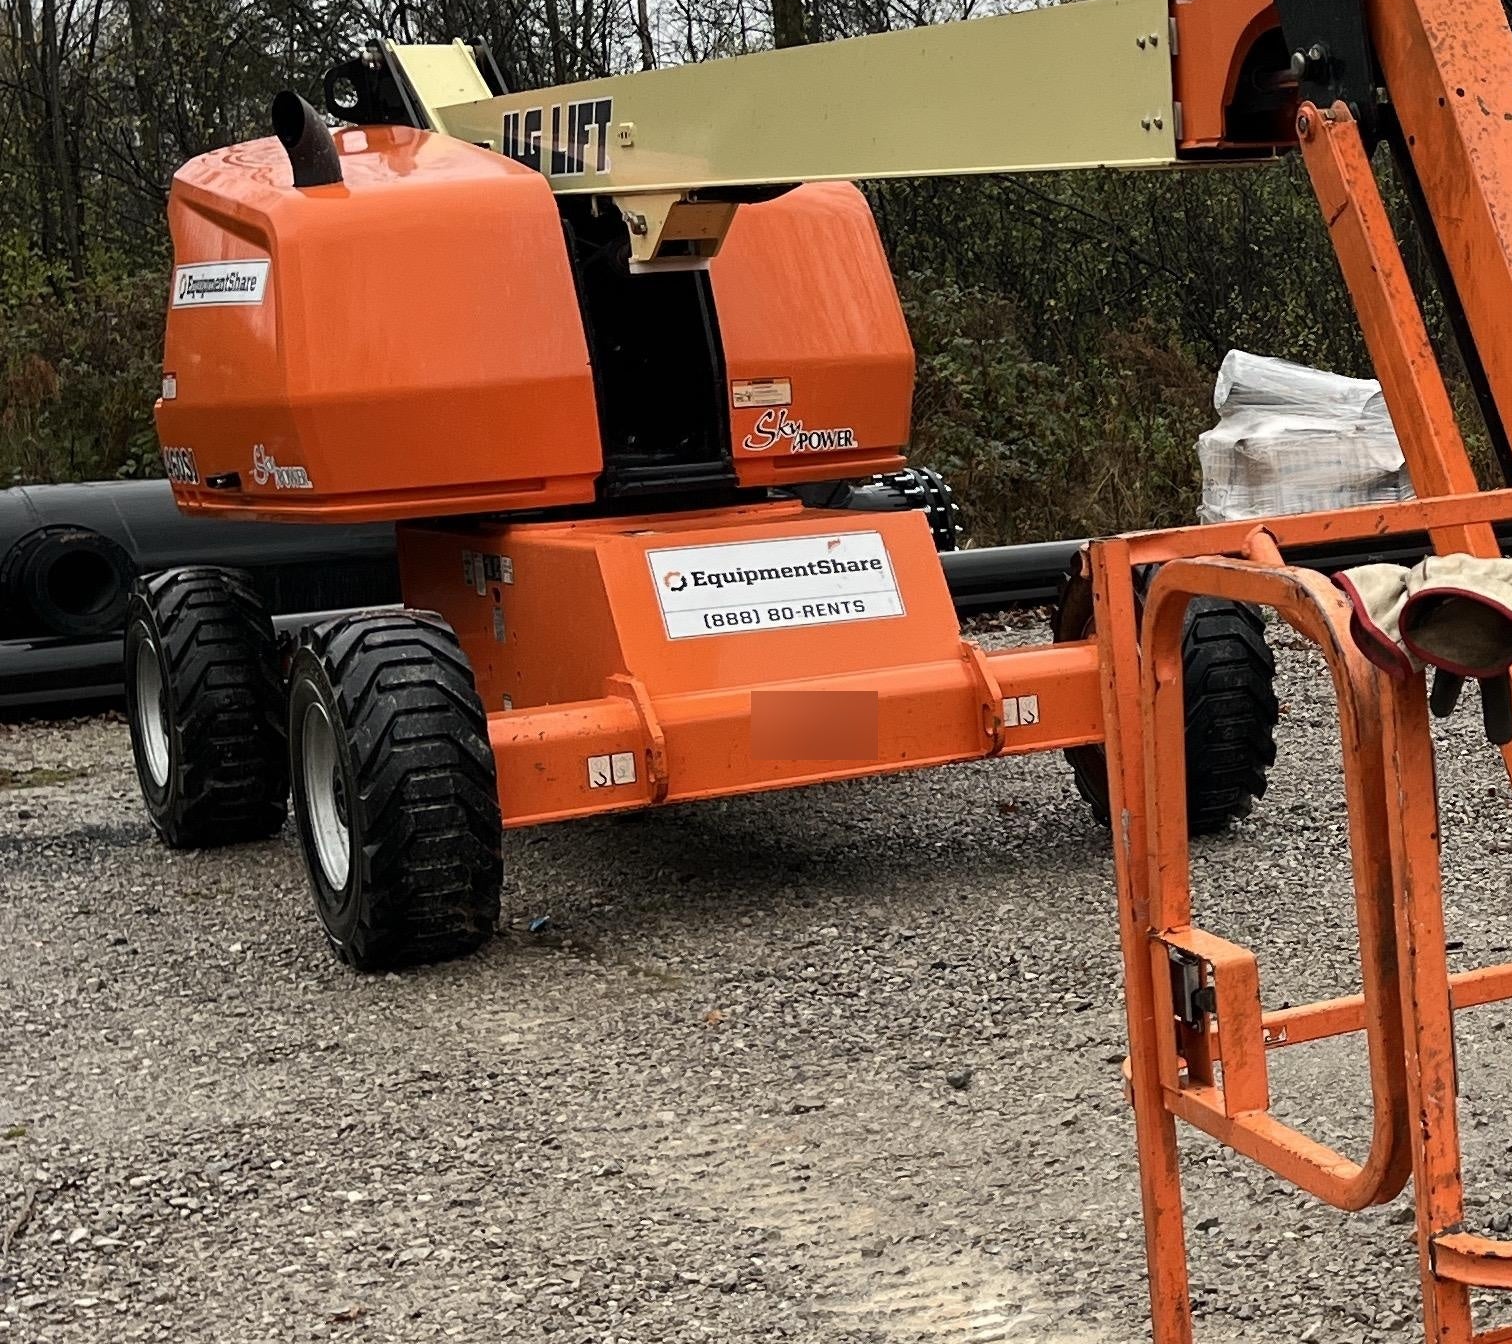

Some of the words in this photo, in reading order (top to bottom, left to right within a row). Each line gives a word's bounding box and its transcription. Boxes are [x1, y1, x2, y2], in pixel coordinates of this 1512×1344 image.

[549, 96, 613, 177] LIFT
[186, 272, 257, 299] EquipmentShare
[743, 409, 804, 454] Sky
[797, 428, 857, 452] POWER
[691, 557, 883, 589] EquipmentShare
[703, 609, 761, 629] (888)
[768, 600, 866, 622] 80-RENTS
